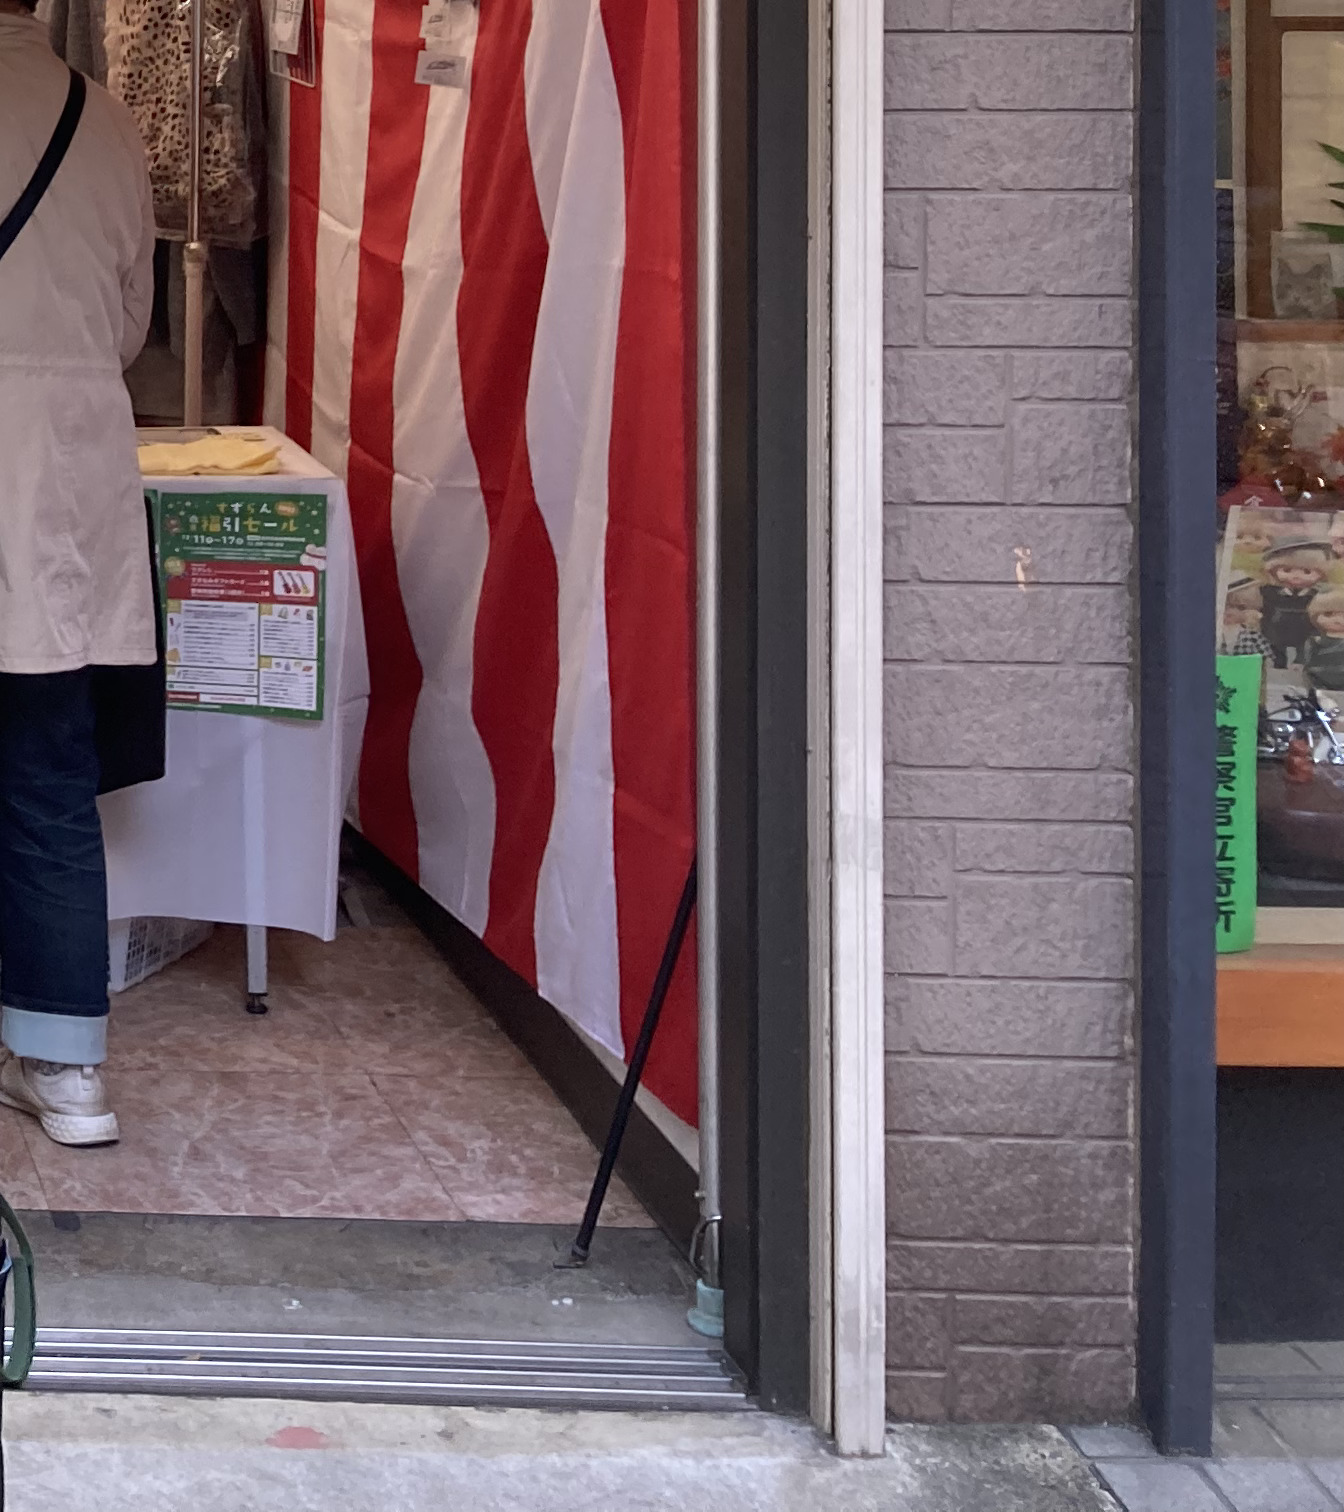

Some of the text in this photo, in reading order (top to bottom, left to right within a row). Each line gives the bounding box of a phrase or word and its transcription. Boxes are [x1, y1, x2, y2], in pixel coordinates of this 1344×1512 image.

[201, 515, 299, 533] 福引セール
